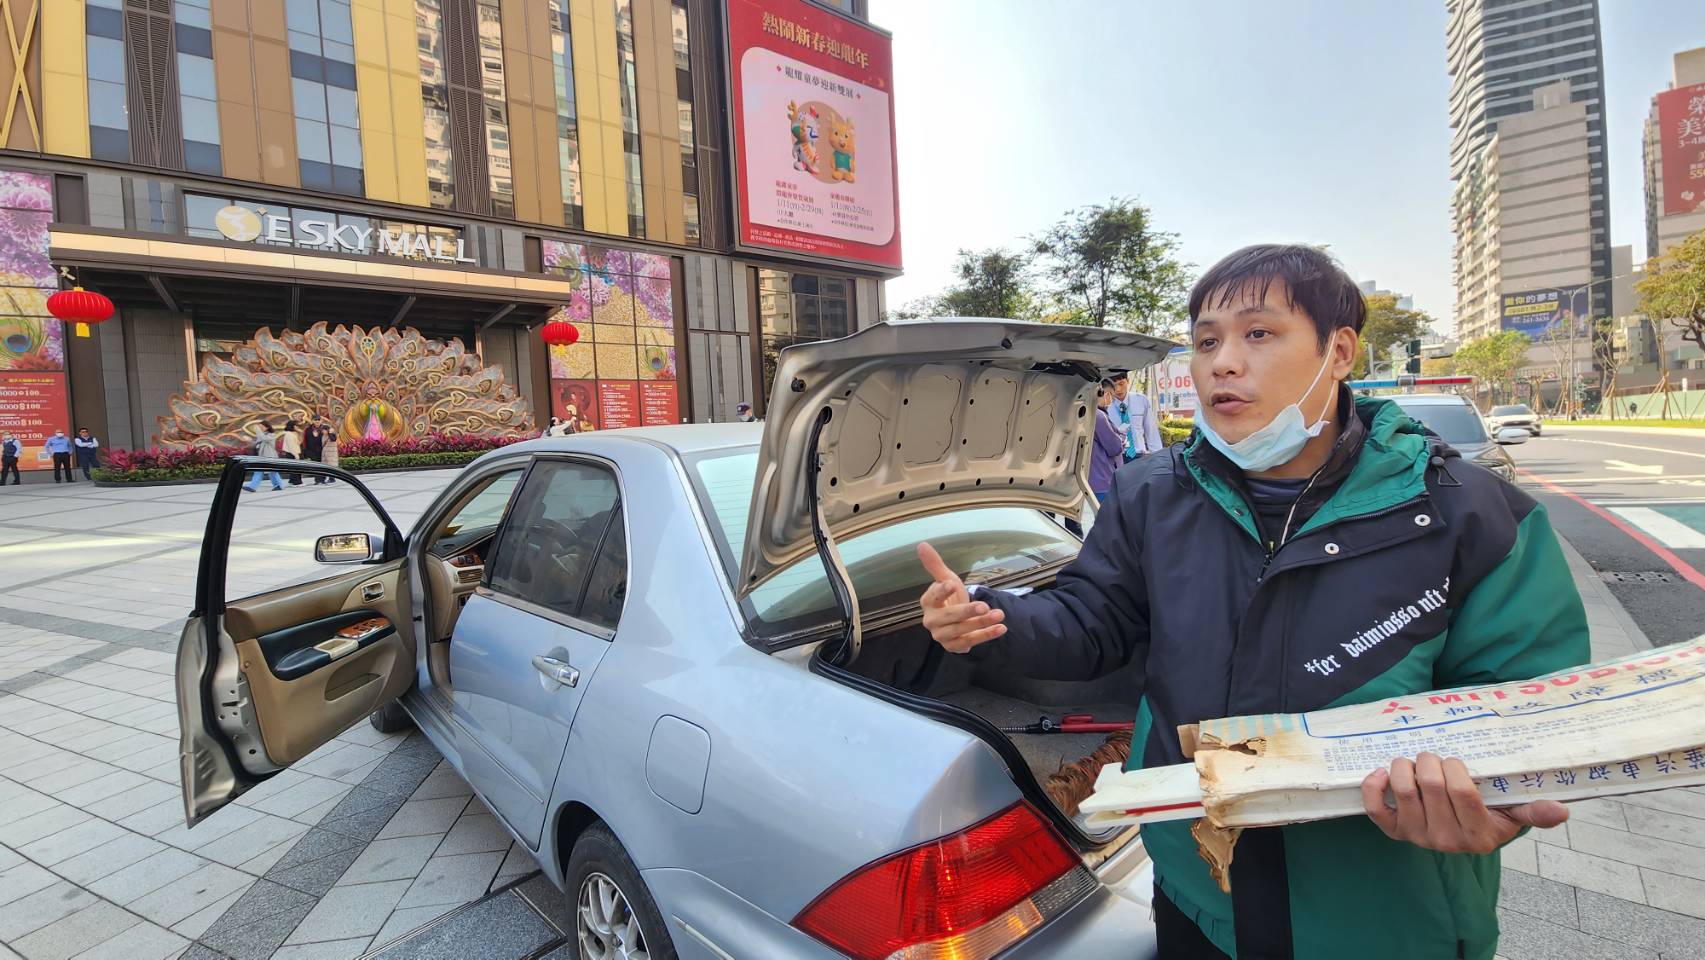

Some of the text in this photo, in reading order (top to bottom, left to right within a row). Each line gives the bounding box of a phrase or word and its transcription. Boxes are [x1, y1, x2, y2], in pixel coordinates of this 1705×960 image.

[762, 11, 869, 69] 熱鬧新春迎龍年
[1678, 117, 1705, 138] 美
[299, 220, 374, 251] SKY
[377, 228, 476, 263] MALL
